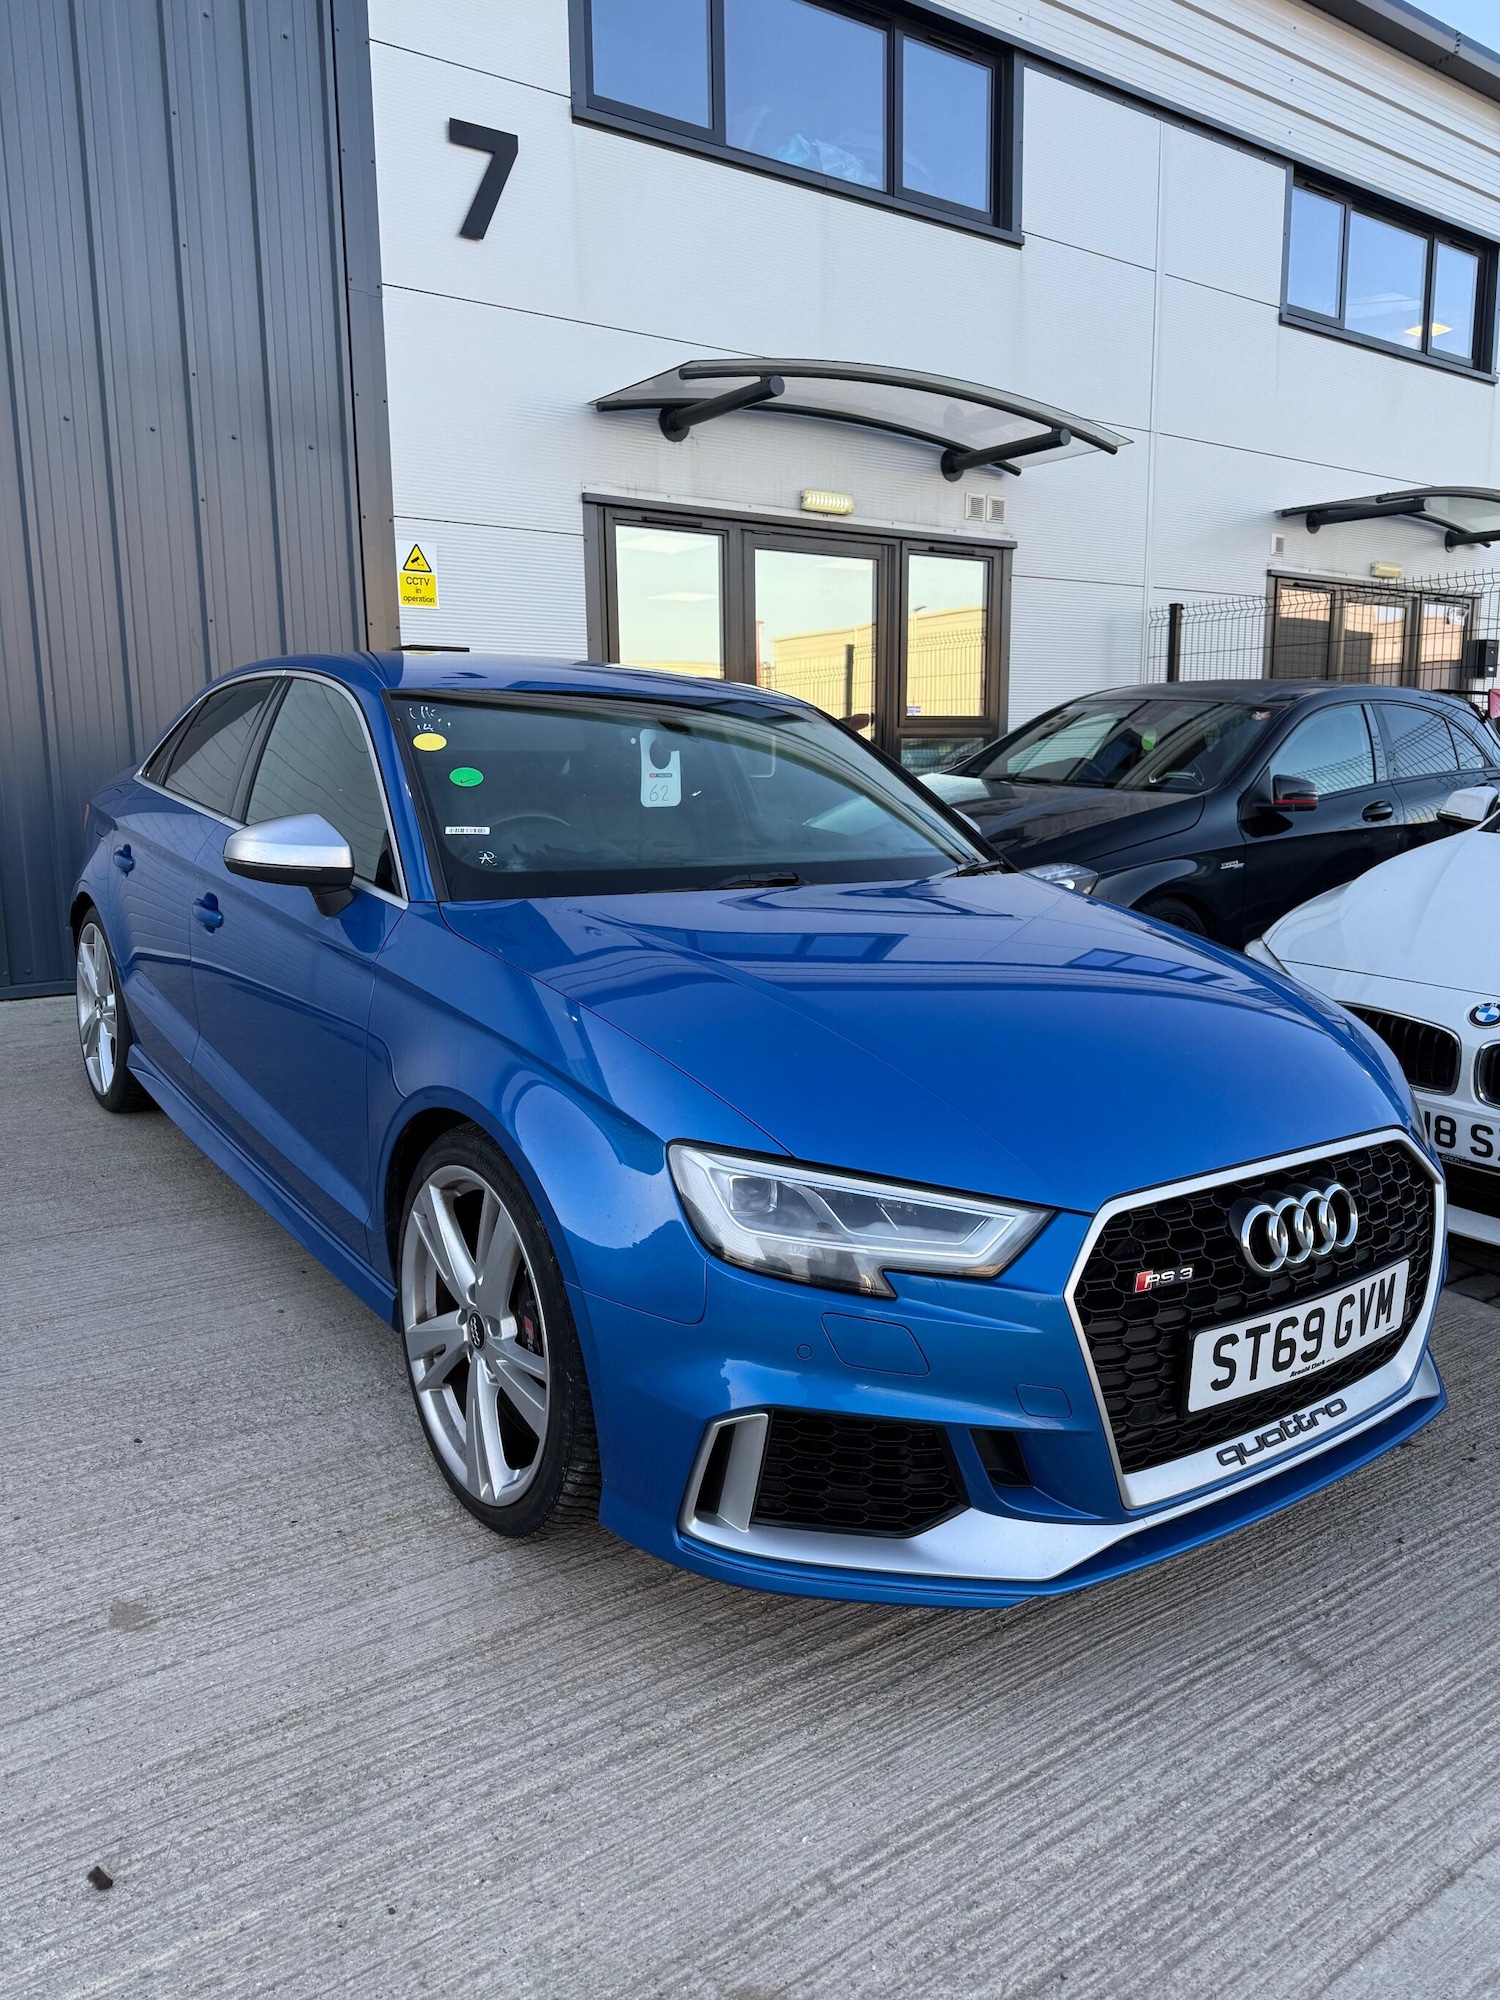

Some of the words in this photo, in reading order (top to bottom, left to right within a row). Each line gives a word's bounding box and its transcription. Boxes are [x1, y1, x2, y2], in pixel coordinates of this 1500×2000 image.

[449, 117, 519, 240] 7
[405, 576, 430, 586] CCTV
[403, 595, 435, 603] operation
[650, 783, 669, 802] 62
[1470, 1123, 1500, 1162] S
[1144, 1270, 1175, 1288] RS
[1179, 1267, 1193, 1280] 3
[1210, 1307, 1326, 1391] ST69
[1333, 1272, 1397, 1349] GVM
[1216, 1398, 1348, 1467] quattro
